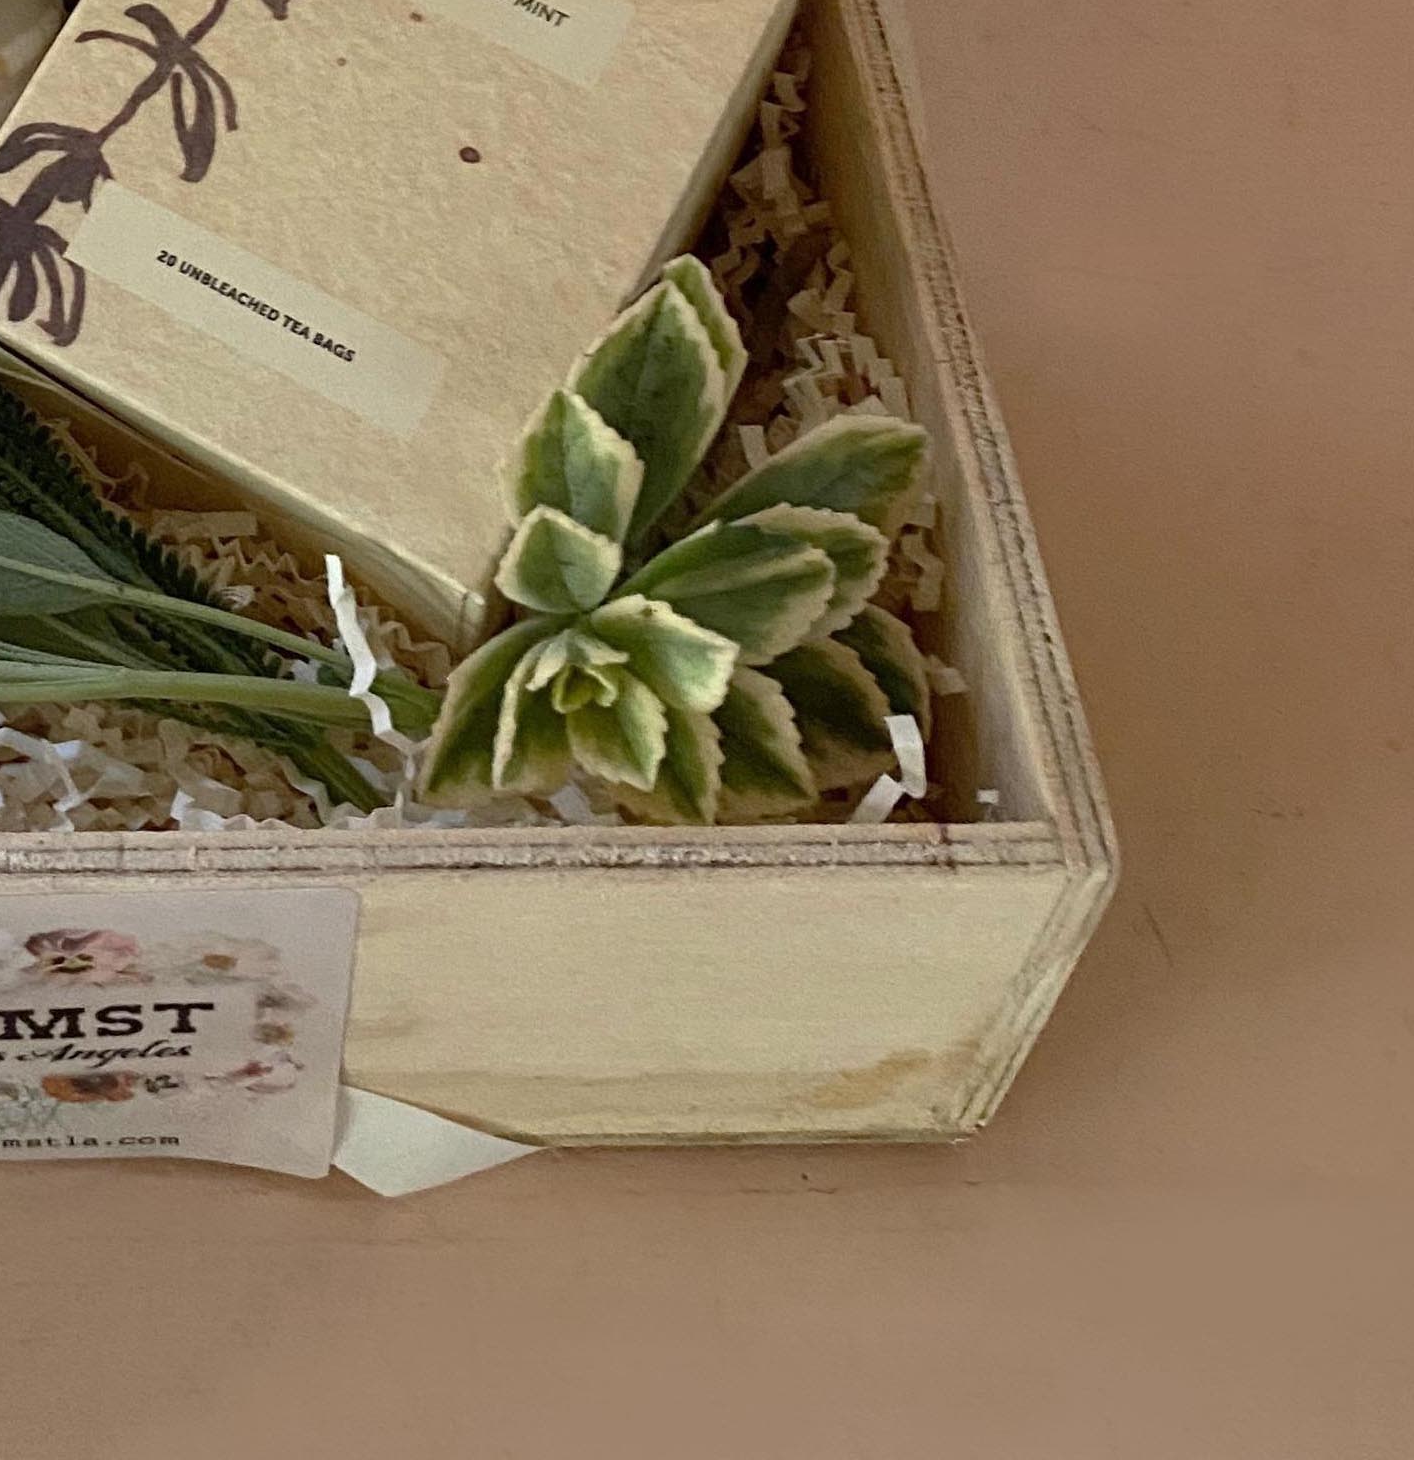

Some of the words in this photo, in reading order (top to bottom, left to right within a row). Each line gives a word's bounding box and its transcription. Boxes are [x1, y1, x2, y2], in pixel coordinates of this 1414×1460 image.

[156, 250, 177, 267] 20
[179, 261, 281, 321] UNBLEACHED
[283, 315, 310, 340] TEA
[312, 333, 357, 363] BAGS
[15, 1039, 193, 1069] Angeles
